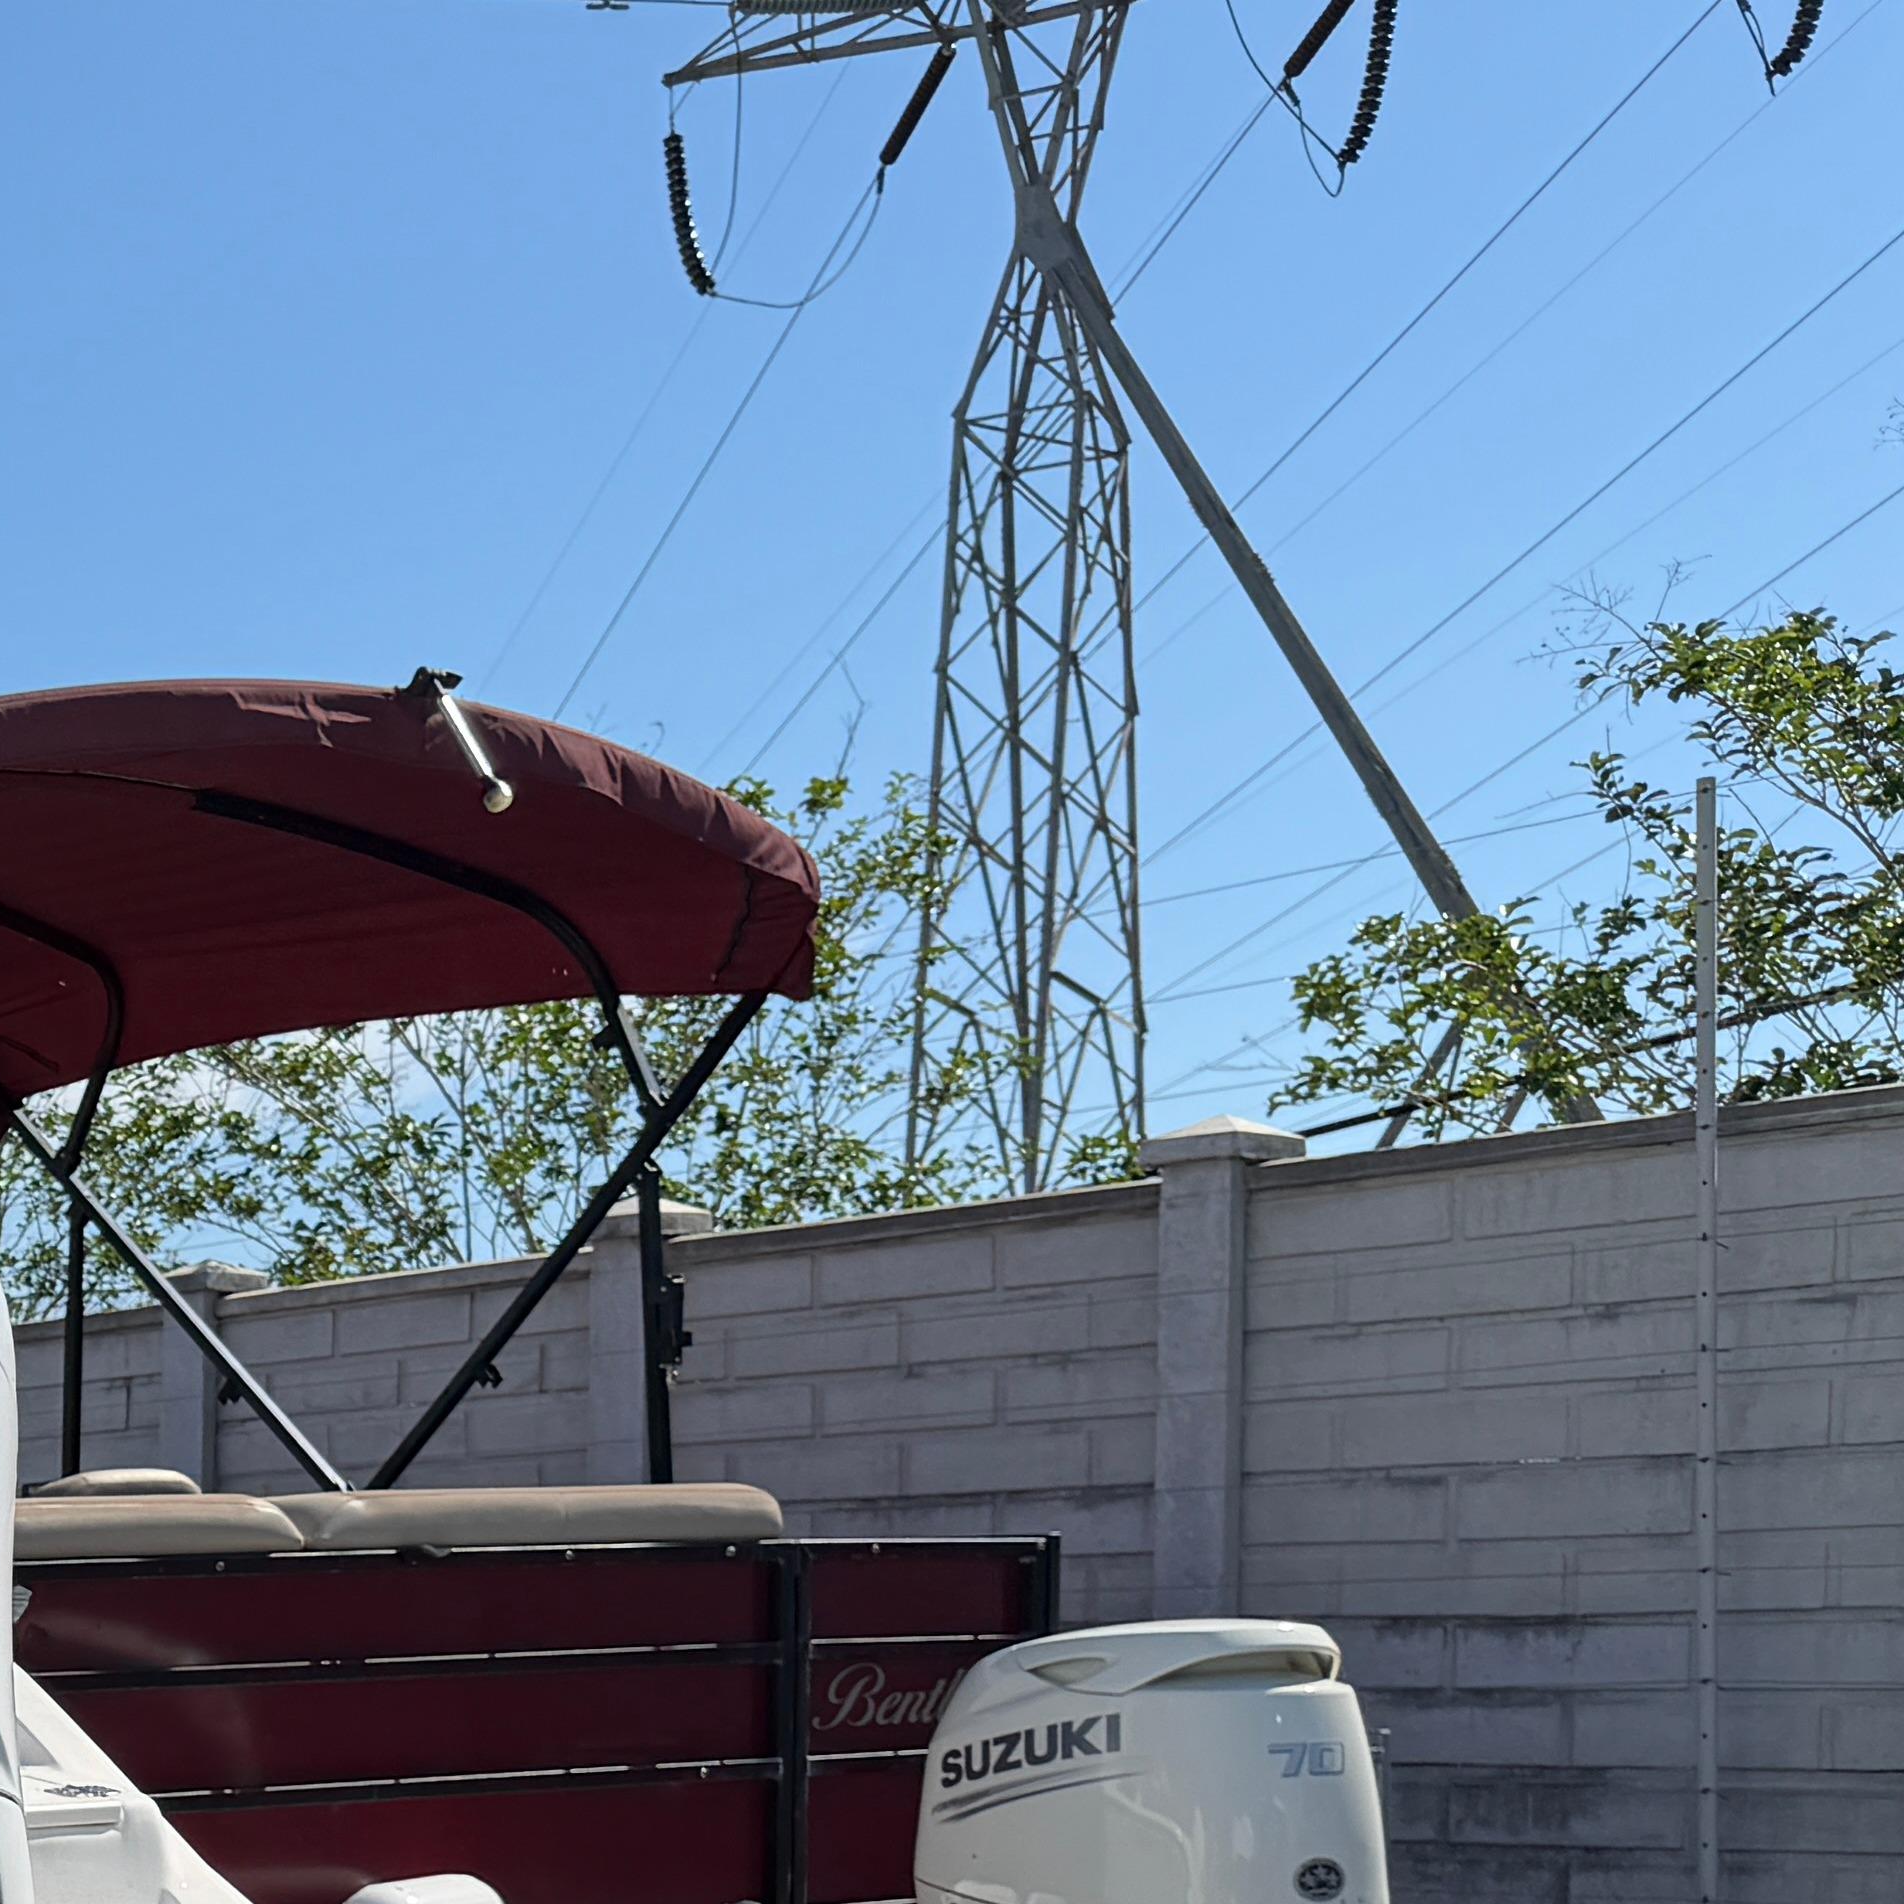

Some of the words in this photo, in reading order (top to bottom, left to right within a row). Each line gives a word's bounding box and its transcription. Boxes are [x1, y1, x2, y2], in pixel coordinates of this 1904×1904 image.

[811, 1661, 966, 1731] Bentl
[940, 1711, 1123, 1789] SUZUKI
[1267, 1742, 1345, 1779] 70
